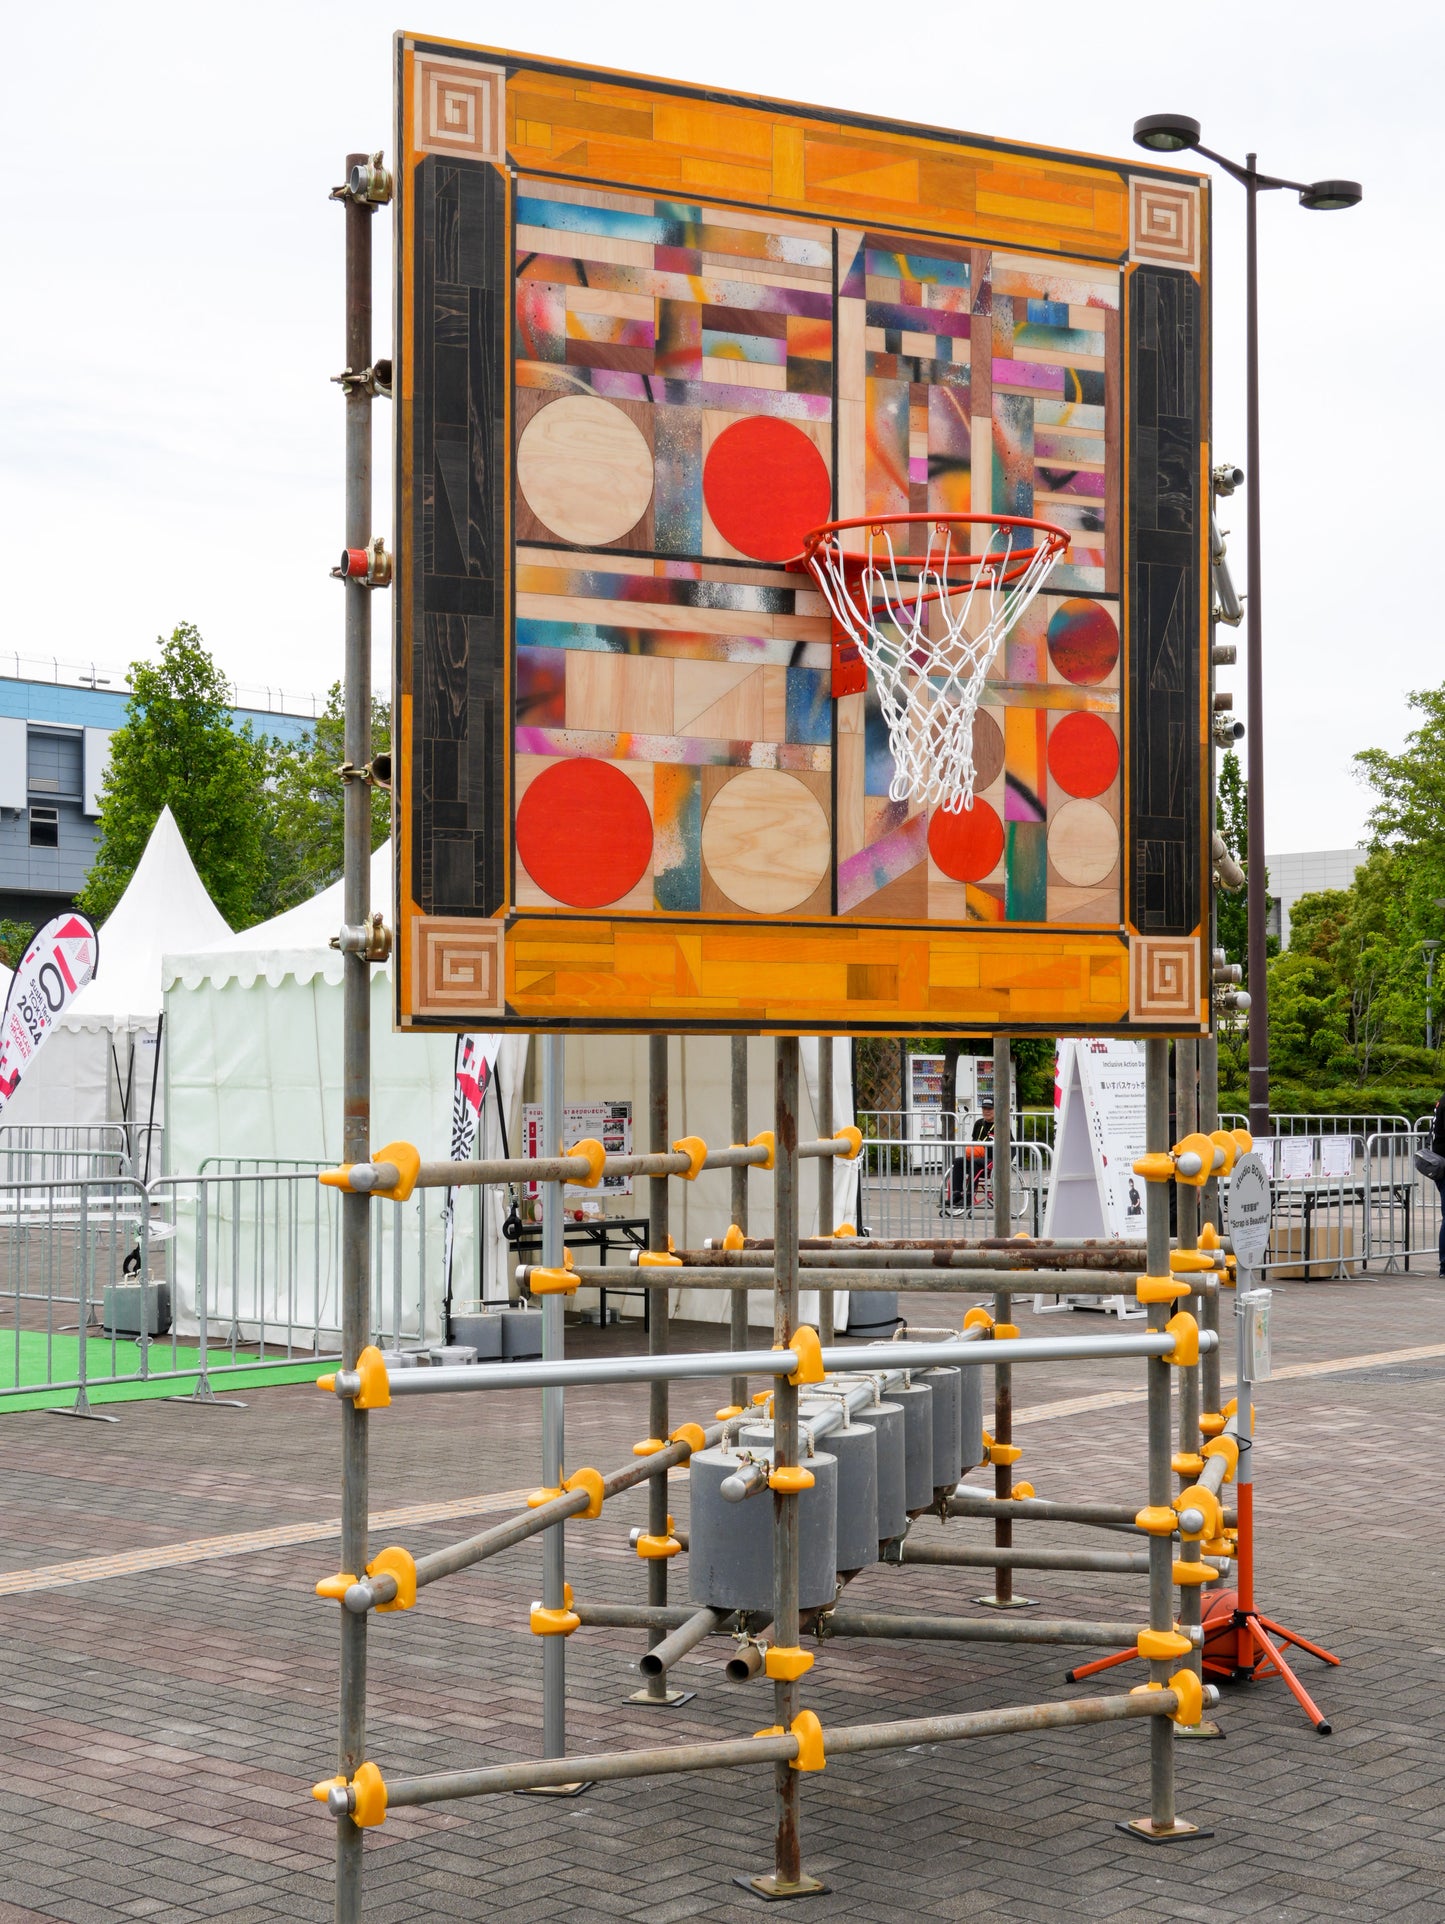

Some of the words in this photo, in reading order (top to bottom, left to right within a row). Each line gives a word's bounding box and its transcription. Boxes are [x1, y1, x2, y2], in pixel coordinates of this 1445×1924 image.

[17, 995, 42, 1045] 2024
[41, 1003, 52, 1027] Tech
[1252, 1164, 1264, 1190] BOWL
